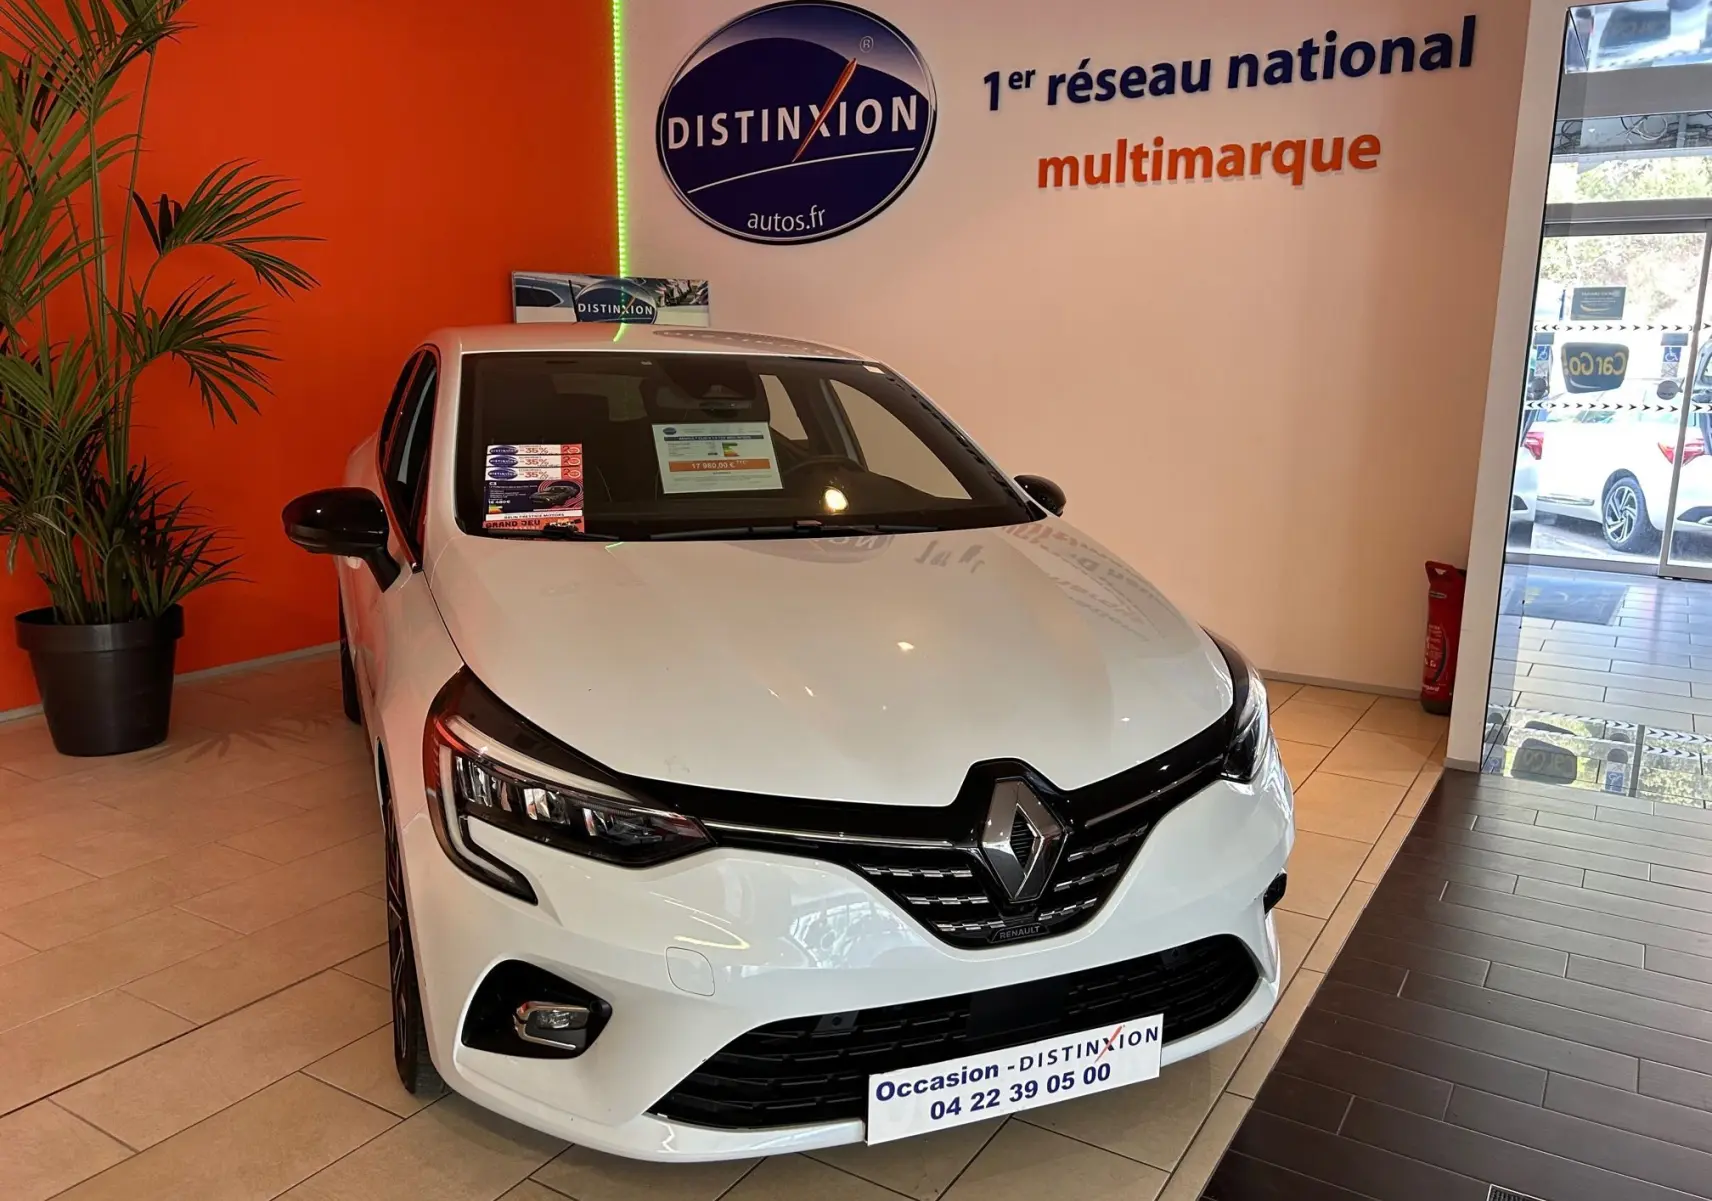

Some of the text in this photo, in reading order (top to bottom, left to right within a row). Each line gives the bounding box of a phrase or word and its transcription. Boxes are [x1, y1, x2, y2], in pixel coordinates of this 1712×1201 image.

[983, 14, 1477, 111] 1er réseau national
[667, 93, 918, 150] DISTINXION
[1037, 132, 1382, 188] multimarque
[746, 204, 826, 232] autos.fr
[578, 302, 653, 315] DISTINXION
[999, 925, 1041, 939] RENAULT
[875, 1062, 1000, 1101] Occasion
[1019, 1025, 1159, 1072] DISTINXION
[930, 1063, 1111, 1121] 04 22 39 05 00
